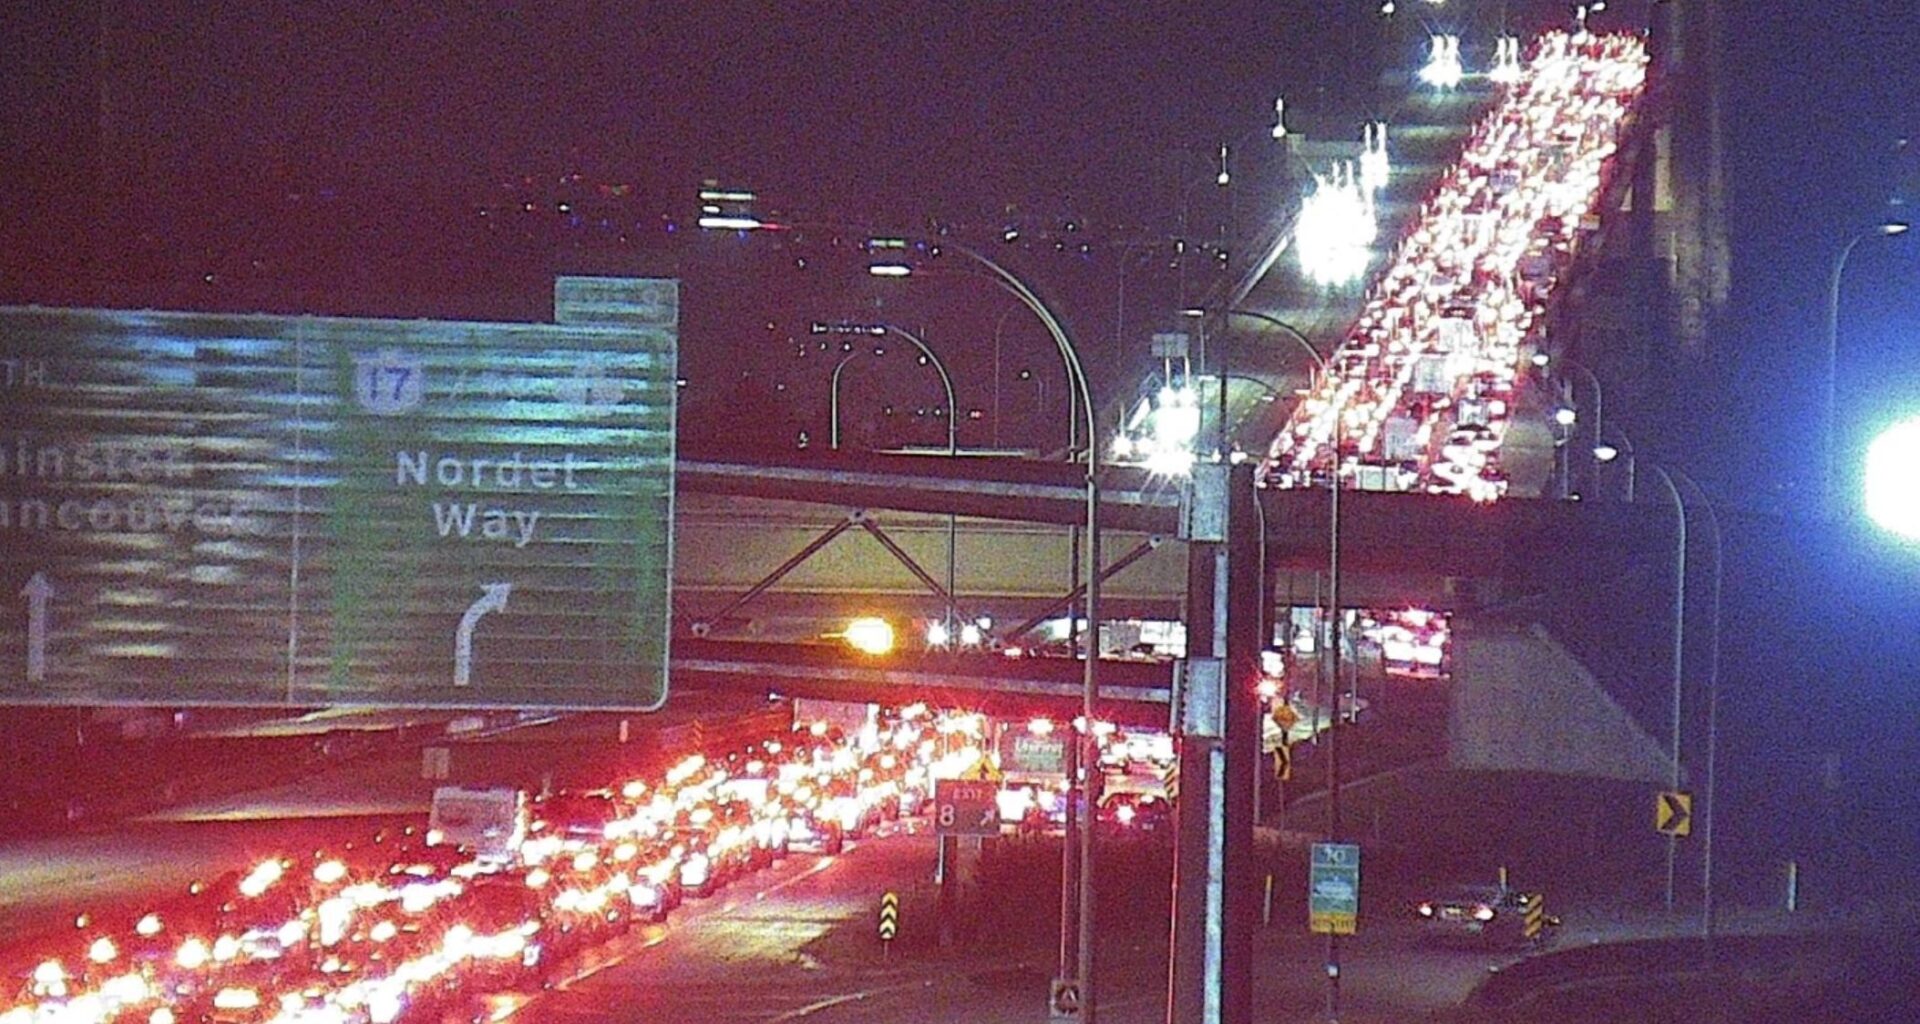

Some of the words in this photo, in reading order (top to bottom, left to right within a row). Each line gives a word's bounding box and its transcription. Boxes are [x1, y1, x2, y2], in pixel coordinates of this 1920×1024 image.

[368, 366, 411, 401] 17
[433, 502, 540, 548] Way
[940, 803, 955, 826] 8
